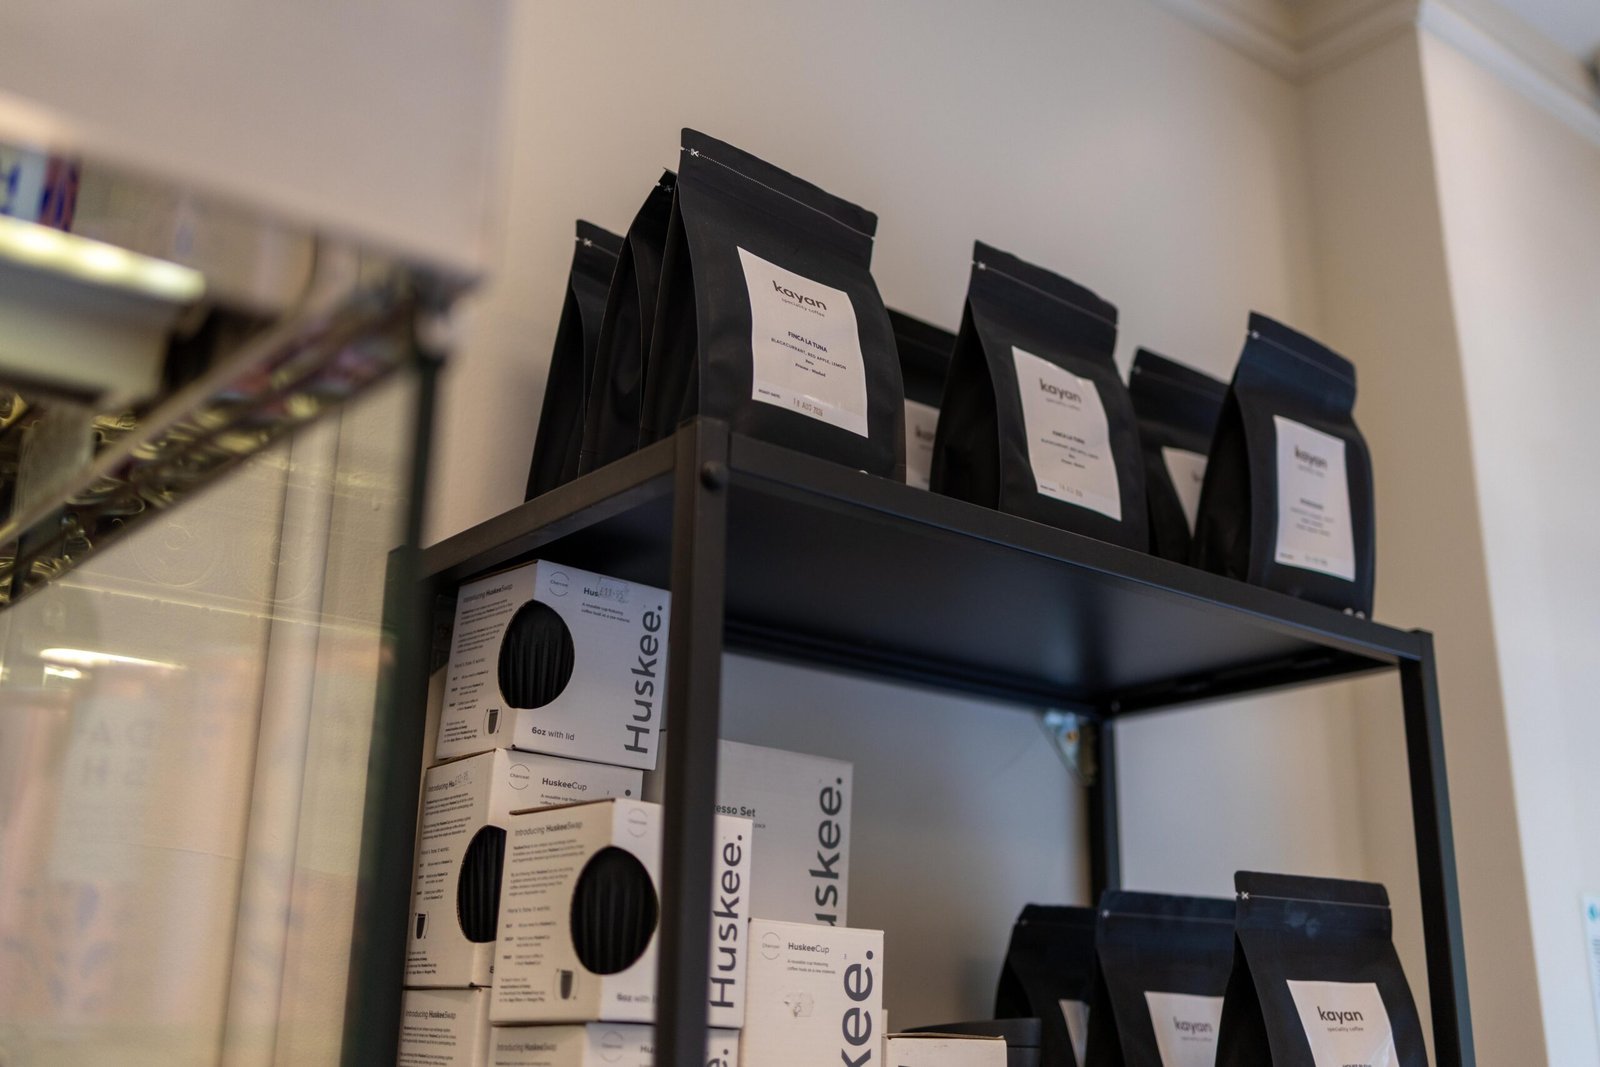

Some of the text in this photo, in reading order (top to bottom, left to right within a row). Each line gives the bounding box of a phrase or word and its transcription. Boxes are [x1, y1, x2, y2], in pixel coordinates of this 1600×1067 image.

[772, 280, 827, 311] kayan
[788, 331, 828, 353] FINCA LA TUNA
[1039, 378, 1082, 403] kayan
[623, 605, 663, 754] Huskee.
[531, 726, 575, 741] 6oz with lid
[541, 777, 588, 792] HuskeeCup
[740, 806, 756, 818] Set
[709, 834, 743, 1009] Huskee.
[787, 942, 830, 955] HuskeeCup
[1317, 1006, 1364, 1025] kayan
[1173, 1016, 1213, 1035] kayan
